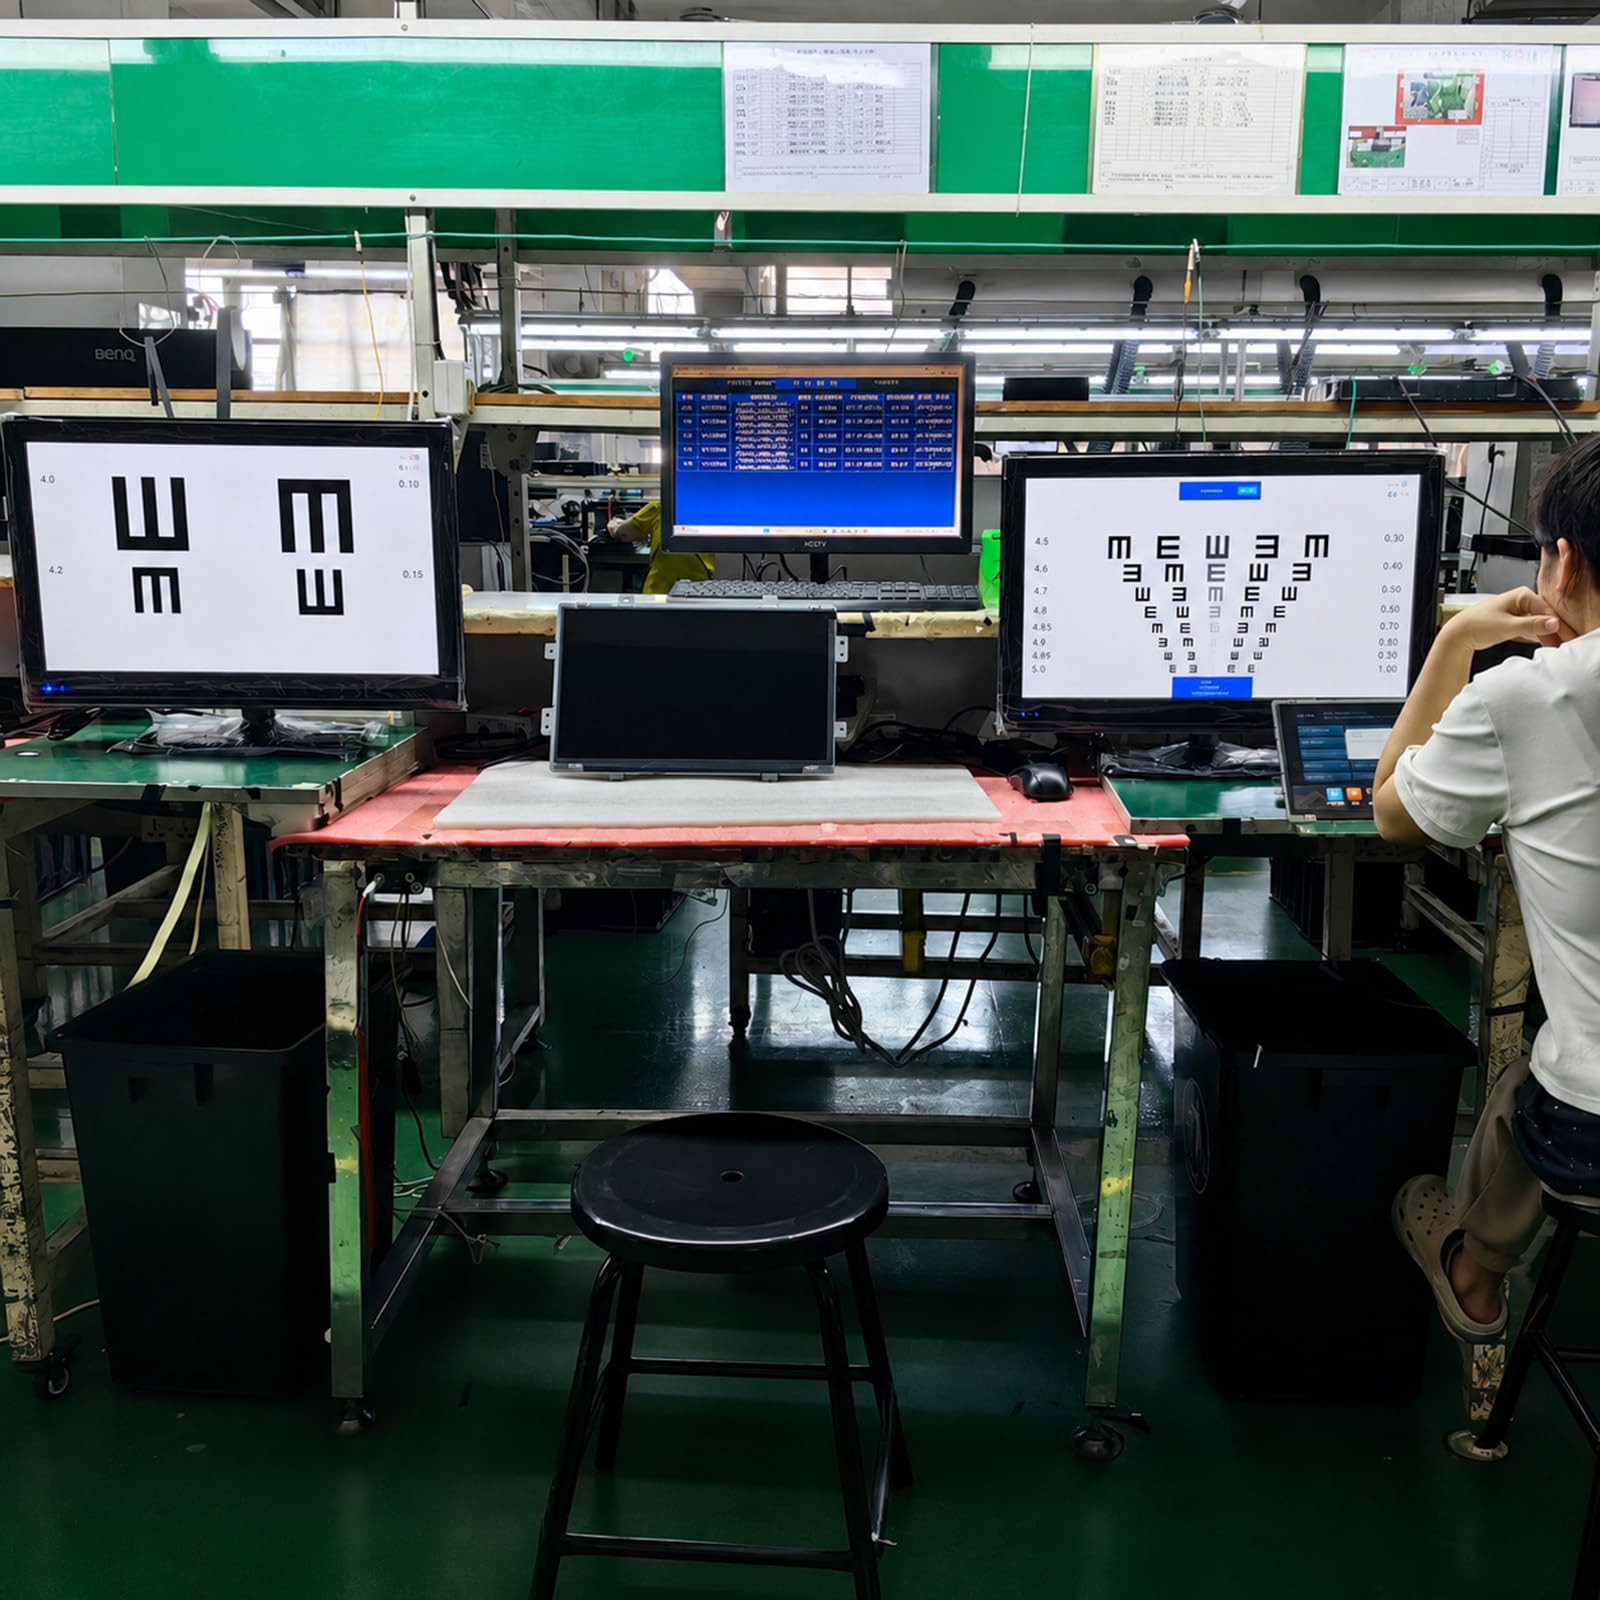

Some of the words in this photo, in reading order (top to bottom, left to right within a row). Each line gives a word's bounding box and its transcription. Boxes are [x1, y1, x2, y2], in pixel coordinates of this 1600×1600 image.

[95, 348, 137, 362] BenQ
[39, 474, 56, 484] 4.0
[398, 479, 420, 489] 0.10
[1034, 536, 1049, 546] 4.5
[1383, 533, 1405, 543] 0.30
[48, 565, 64, 575] 4.2
[402, 569, 424, 579] 0.15
[1033, 564, 1049, 574] 4.6
[1382, 561, 1403, 571] 0.40
[1033, 586, 1048, 596] 4.7
[1381, 584, 1403, 594] 0.50
[1032, 605, 1048, 615] 4.8
[1032, 622, 1053, 632] 4.85
[1379, 621, 1400, 631] 0.70
[1032, 637, 1047, 647] 4.9
[1031, 664, 1046, 674] 5.0
[1378, 664, 1398, 673] 1.00
